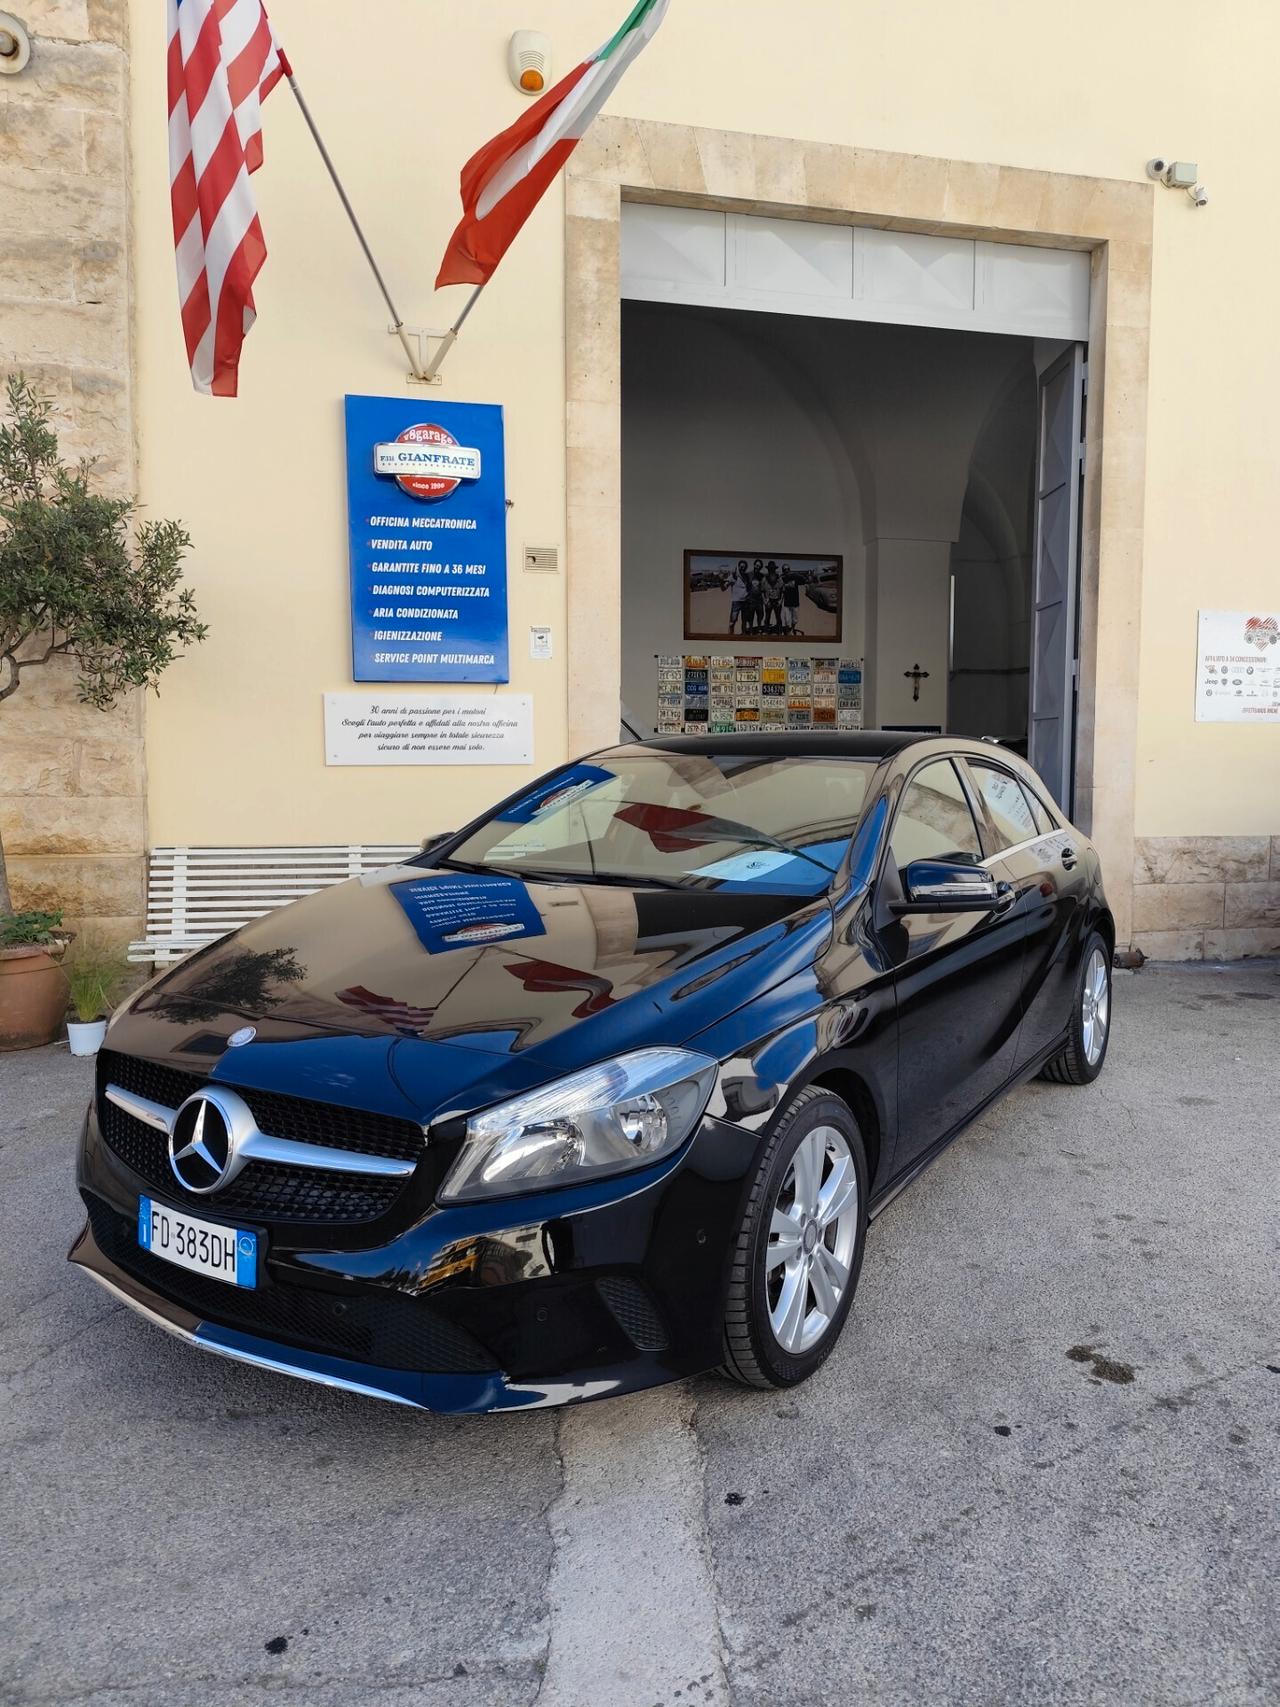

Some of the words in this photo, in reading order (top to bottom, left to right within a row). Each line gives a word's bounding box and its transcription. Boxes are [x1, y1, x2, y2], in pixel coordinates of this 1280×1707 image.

[398, 452, 476, 467] GIANFRATE
[370, 516, 410, 527] OFFICINA
[412, 517, 477, 530] MECCATRONICA
[371, 539, 408, 550] VENDITA
[409, 540, 433, 551] AUTO
[372, 562, 420, 573] GARANTITE
[421, 563, 441, 574] FINO
[443, 563, 450, 574] A
[451, 564, 463, 574] 36
[465, 564, 486, 575] MESI
[373, 585, 414, 596] DIAGNOSI
[416, 586, 490, 597] COMPUTERIZZATA
[373, 608, 394, 618] ARIA
[396, 608, 459, 619] CONDIZIONATA
[374, 630, 443, 641] IGIENIZZAZIONE
[374, 653, 410, 664] SERVICE
[411, 653, 439, 664] POINT
[440, 654, 495, 665] MULTIMARCA
[381, 707, 399, 715] anni
[400, 706, 408, 715] di
[408, 707, 441, 716] passione
[442, 708, 455, 716] per
[462, 707, 488, 715] motori
[341, 718, 366, 728] Scegli
[366, 719, 387, 727] l'auto
[387, 719, 416, 728] perfetta
[425, 719, 451, 728] affidati
[452, 719, 466, 727] alla
[491, 719, 519, 728] officina
[358, 732, 372, 740] per
[373, 731, 409, 740] viaggiare
[411, 732, 438, 740] sempre
[439, 731, 448, 739] in
[449, 731, 469, 739] totale
[471, 731, 505, 739] sicurezza
[377, 743, 401, 751] sicuro
[402, 743, 410, 751] di
[452, 743, 467, 751] mai
[151, 1210, 170, 1249] FD
[175, 1221, 236, 1273] 383DH
